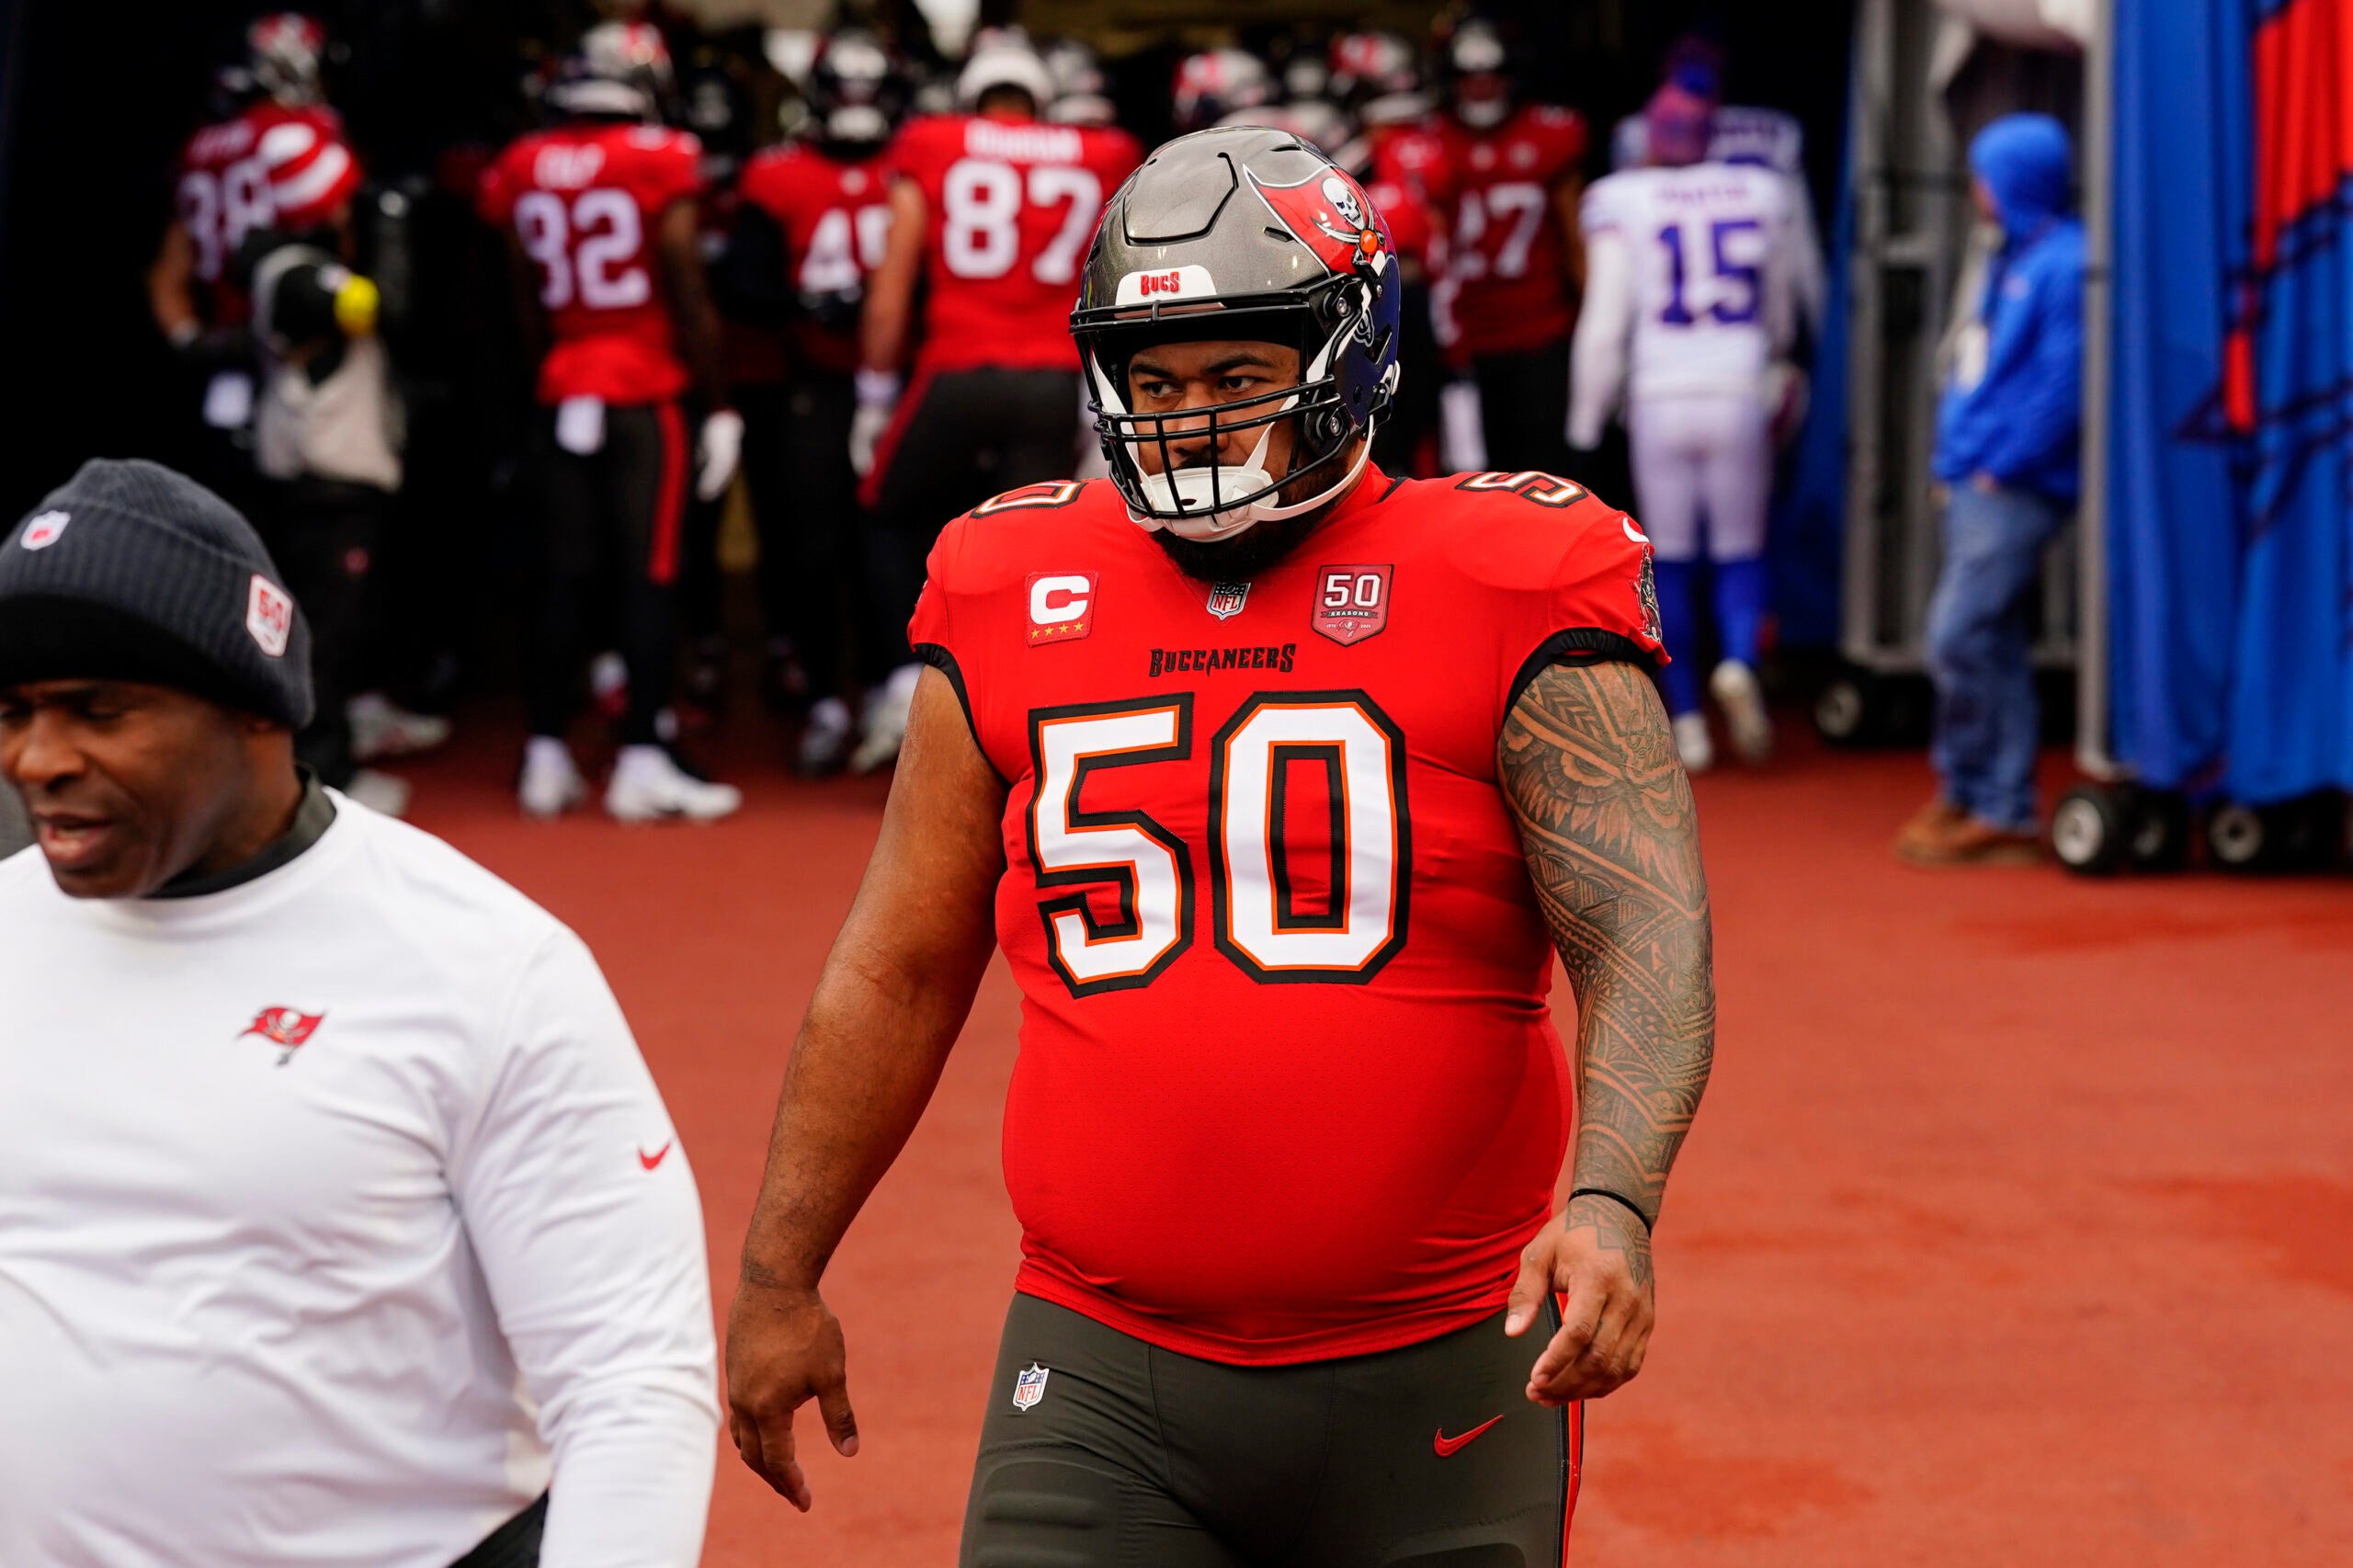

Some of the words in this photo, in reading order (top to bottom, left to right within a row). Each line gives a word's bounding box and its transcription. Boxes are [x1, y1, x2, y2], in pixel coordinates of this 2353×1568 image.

[944, 160, 1101, 284] 87
[1141, 271, 1179, 295] BUCS
[1659, 221, 1762, 324] 15
[1030, 575, 1090, 625] C
[1212, 595, 1241, 611] NFL
[1324, 574, 1381, 608] 50
[1149, 643, 1296, 677] BUCCANEERS
[1026, 688, 1412, 999] 50
[1017, 1384, 1038, 1403] NFL
